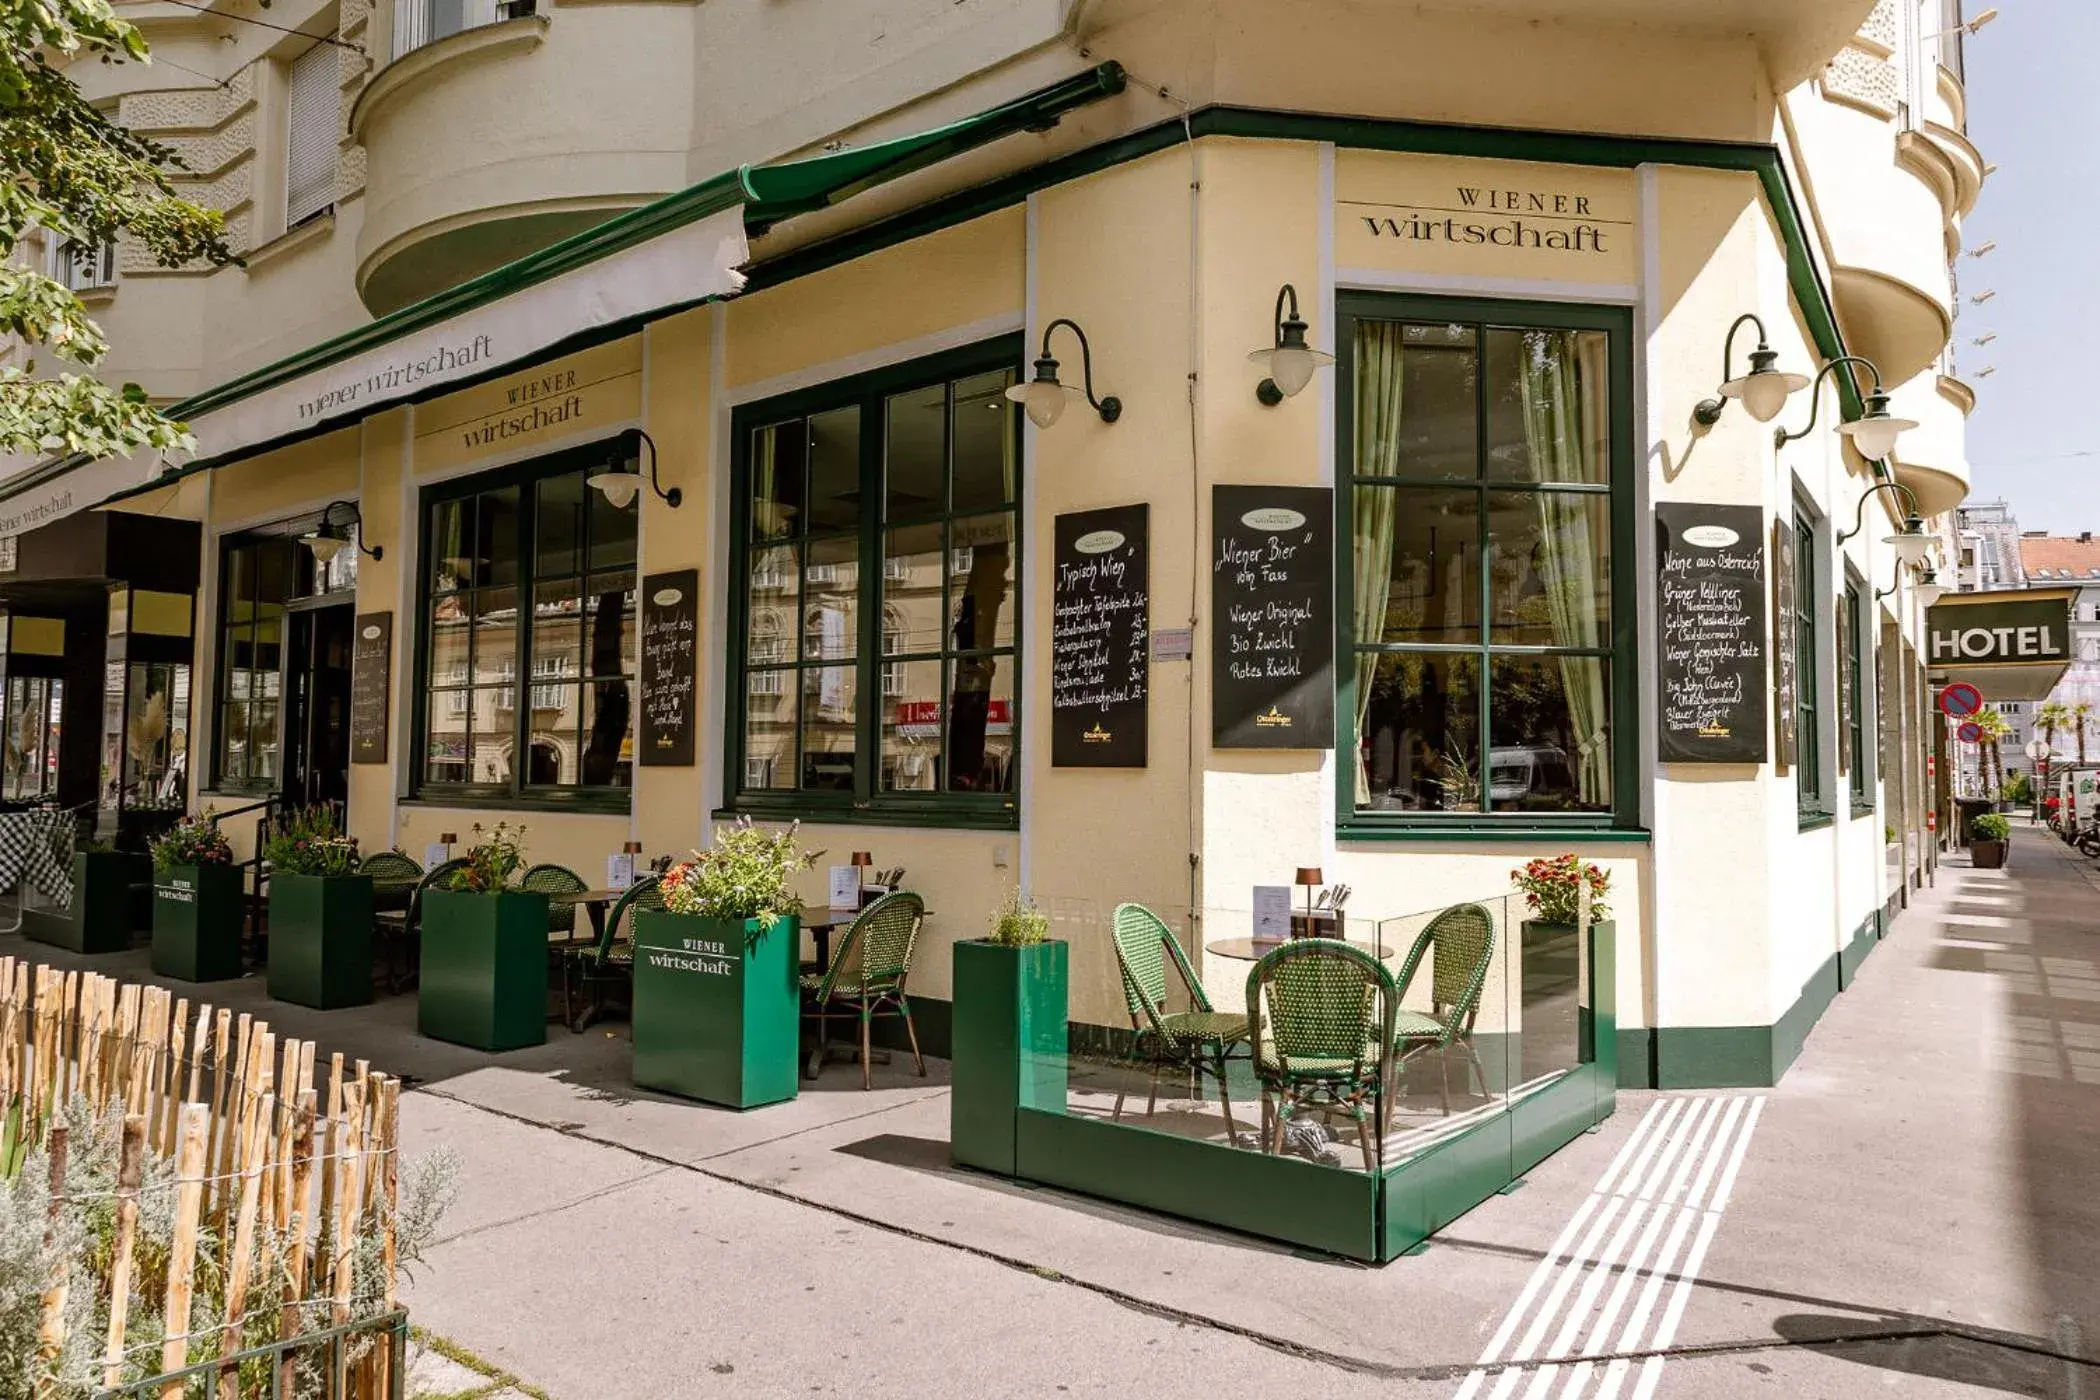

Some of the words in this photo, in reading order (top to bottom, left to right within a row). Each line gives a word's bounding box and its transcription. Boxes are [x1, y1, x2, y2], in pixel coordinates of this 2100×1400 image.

[1456, 187, 1592, 215] WIENER
[1361, 214, 1609, 253] wirtschaft
[298, 381, 362, 418] wiener
[366, 335, 494, 393] wirtschaft
[506, 370, 577, 404] WIENER
[463, 395, 584, 448] wirtschaft
[1261, 563, 1288, 582] Fass
[1696, 556, 1716, 568] aus
[1229, 603, 1263, 631] Wiener
[1266, 597, 1312, 629] Original
[1229, 632, 1250, 654] Bio
[1255, 629, 1296, 651] Zwickl
[1932, 625, 2061, 660] HOTEL
[1228, 660, 1262, 679] Rotes
[1265, 655, 1302, 677] Zwickl
[682, 938, 726, 954] WIENER
[648, 953, 733, 976] wirtschaft
